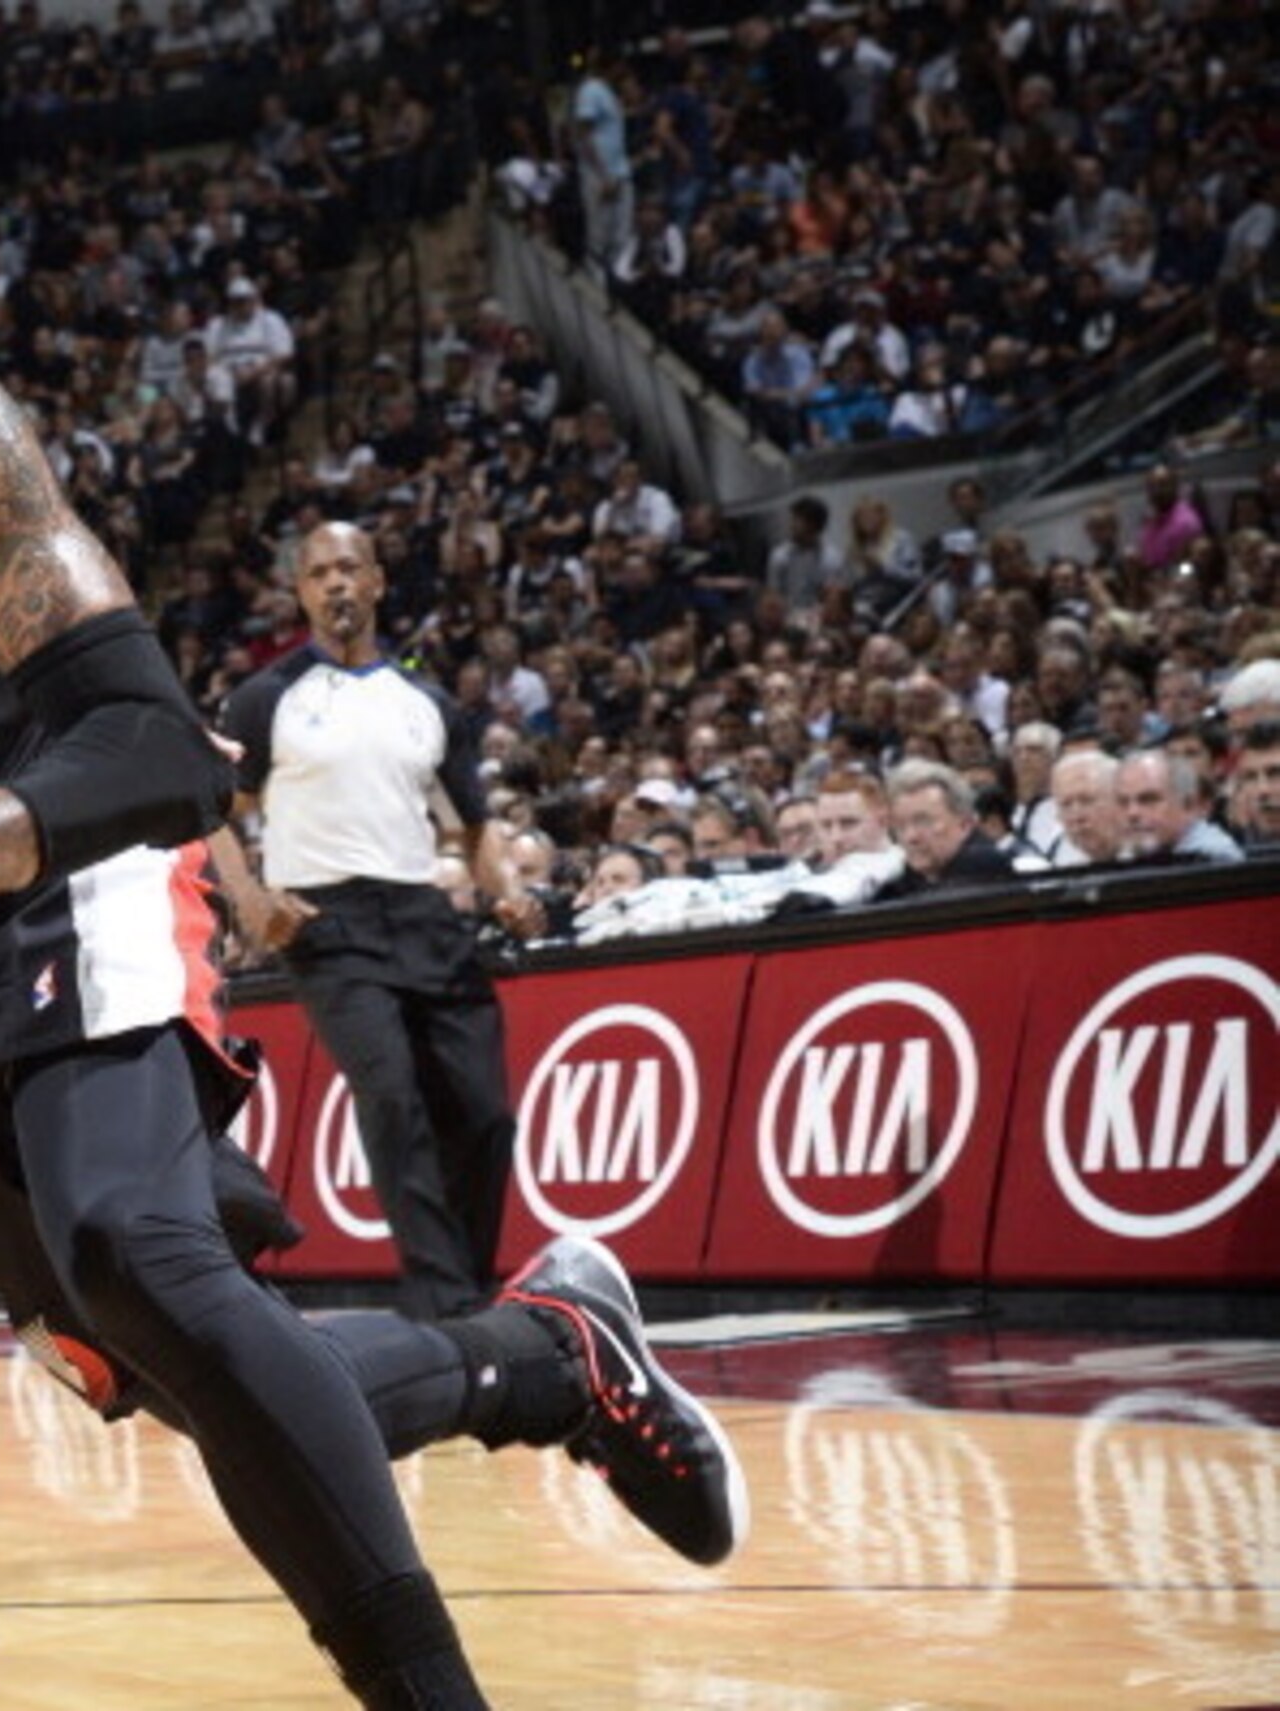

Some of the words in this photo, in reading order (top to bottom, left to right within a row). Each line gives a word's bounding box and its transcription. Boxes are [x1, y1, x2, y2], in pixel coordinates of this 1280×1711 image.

[538, 1058, 661, 1183] KIA
[787, 1037, 931, 1178] KIA
[1081, 1016, 1248, 1173] KIA
